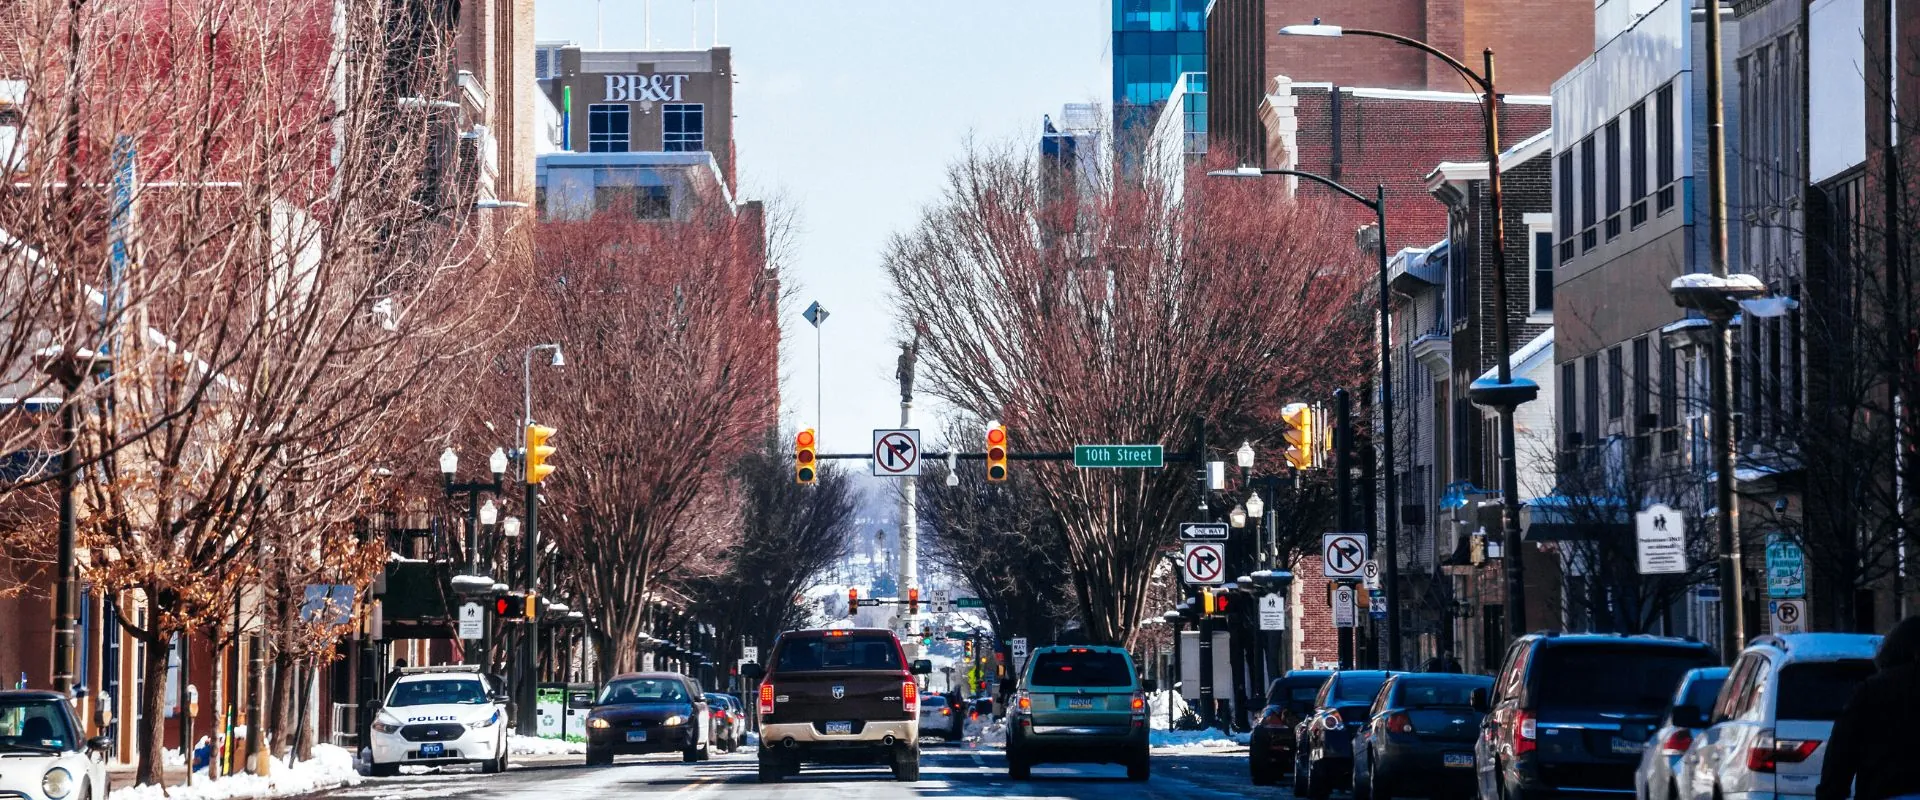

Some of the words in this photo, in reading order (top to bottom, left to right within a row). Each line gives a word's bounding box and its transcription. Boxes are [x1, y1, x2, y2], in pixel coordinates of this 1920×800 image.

[602, 74, 690, 102] BB&T
[1086, 448, 1110, 461] 10th
[1117, 448, 1152, 461] Street
